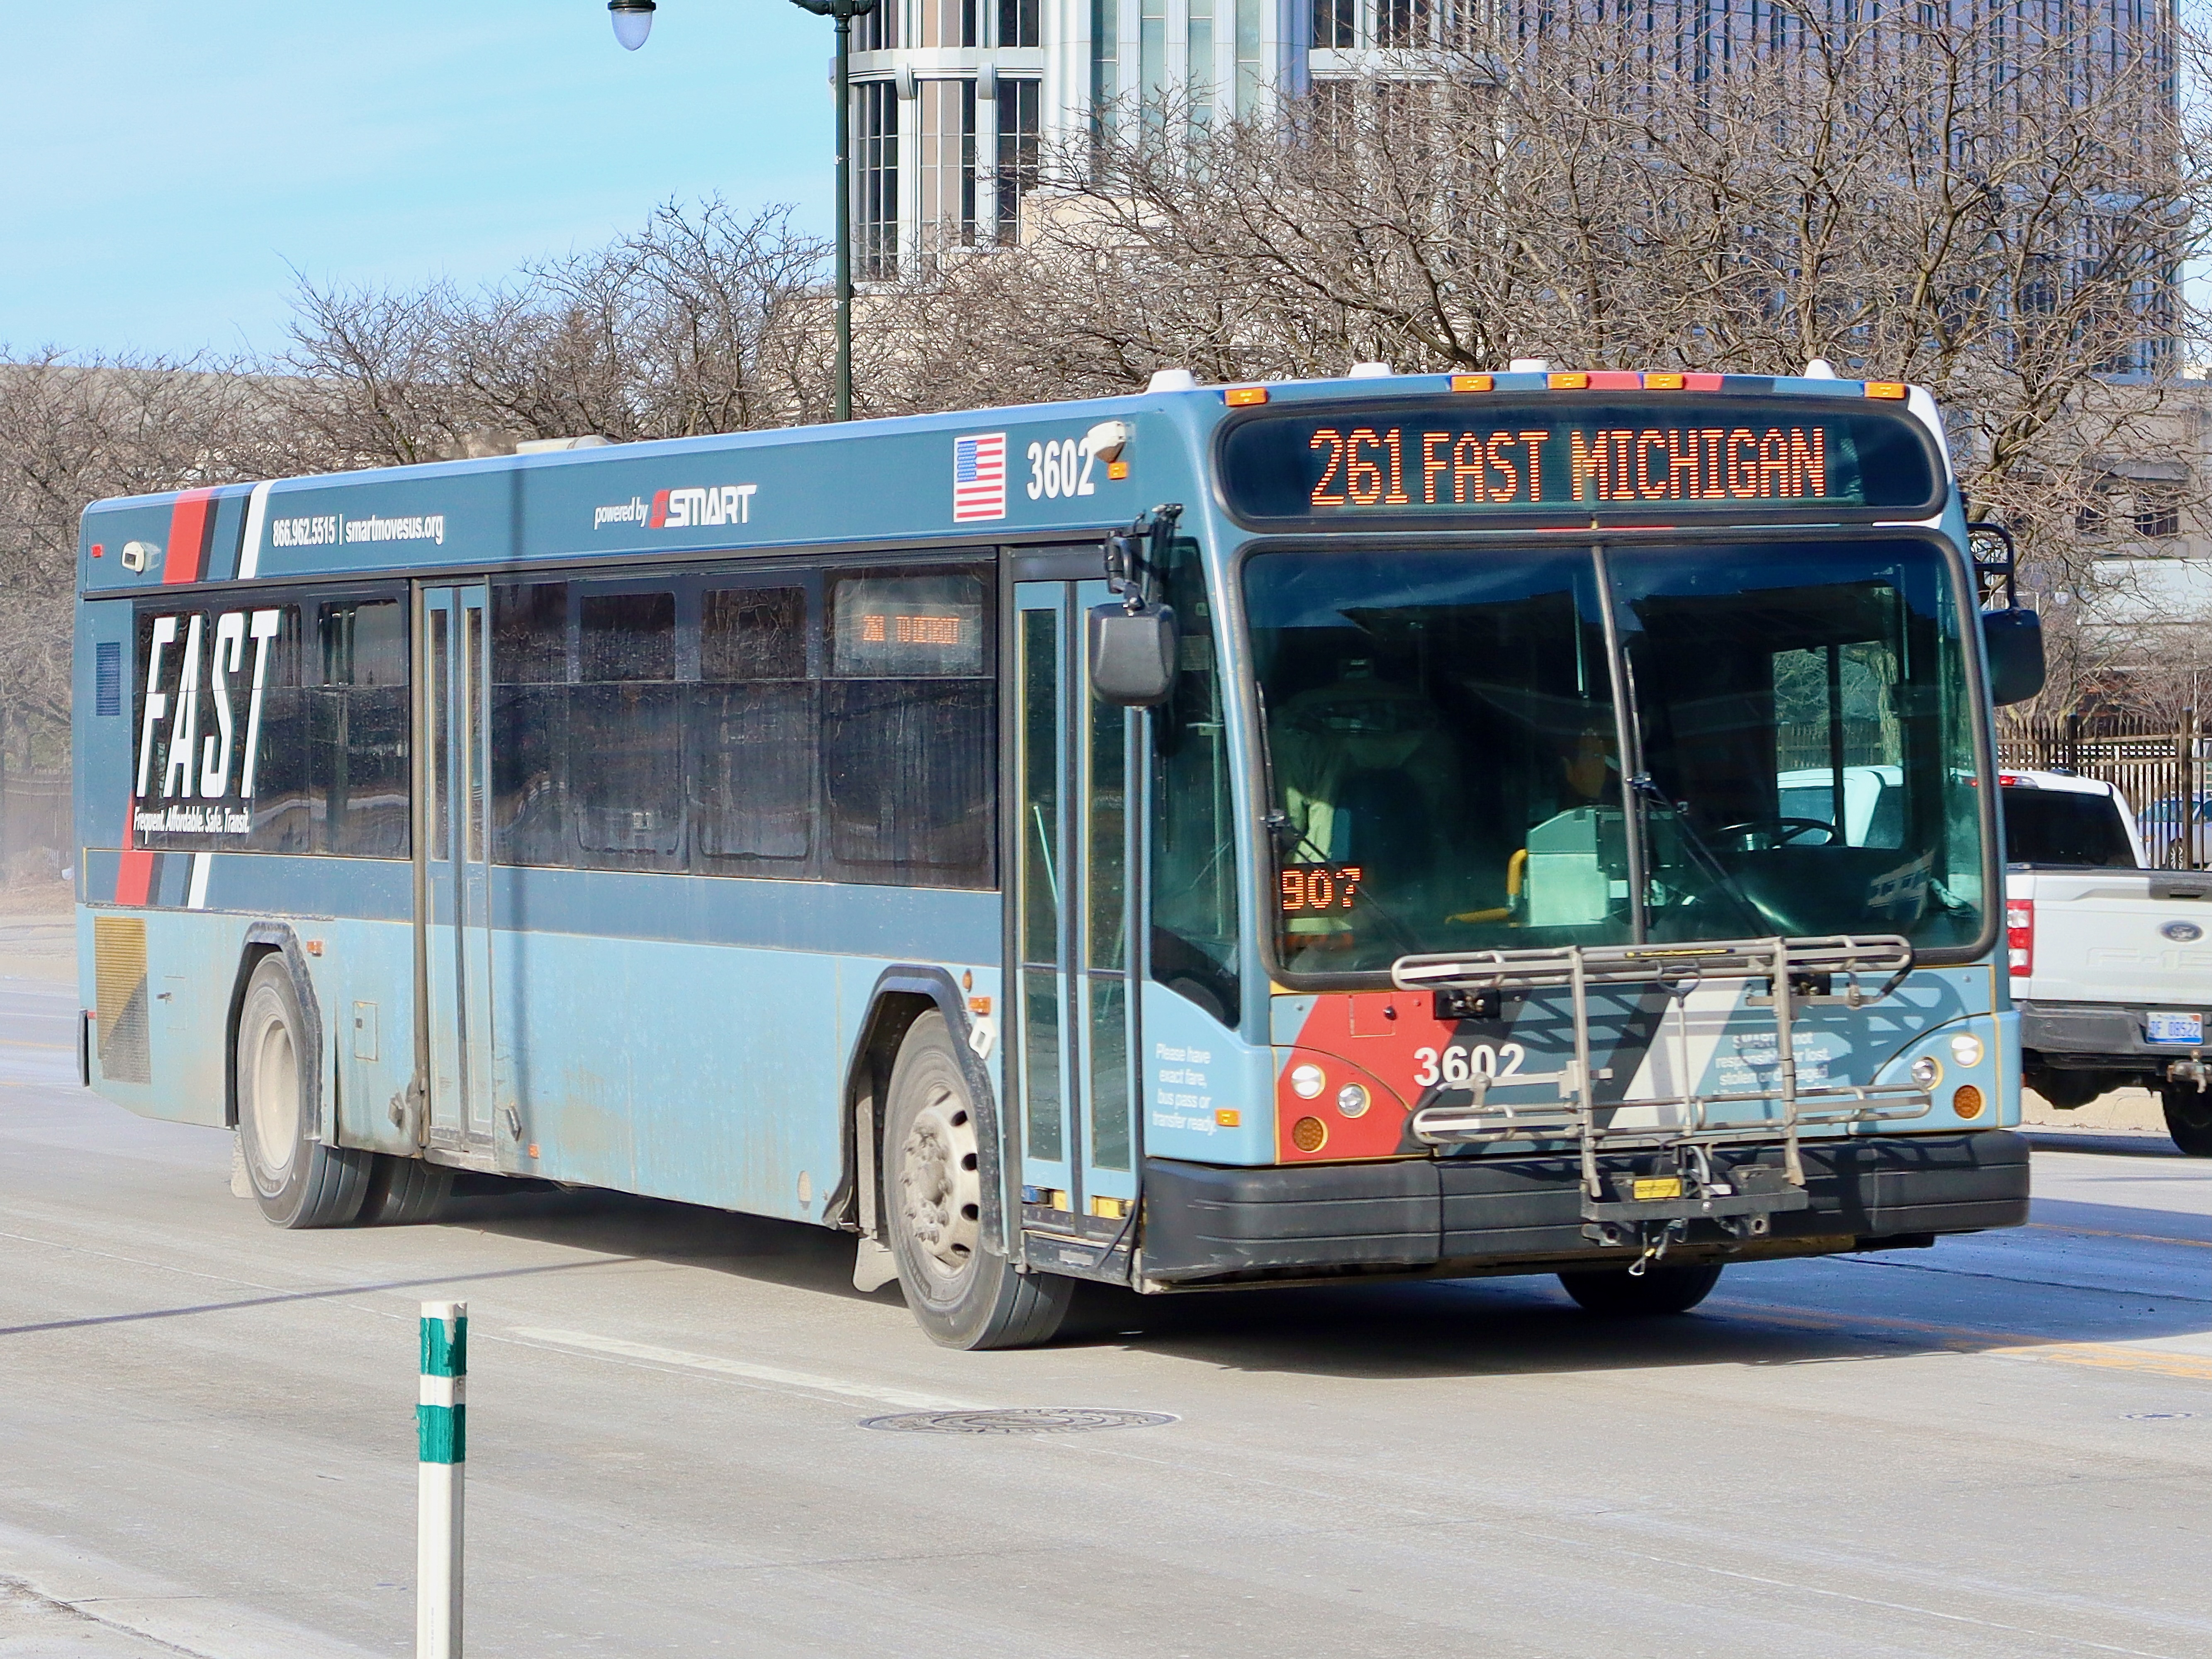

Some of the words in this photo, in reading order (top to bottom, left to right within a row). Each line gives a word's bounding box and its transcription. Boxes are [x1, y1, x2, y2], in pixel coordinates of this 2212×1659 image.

[1027, 438, 1095, 500] 3602
[1310, 427, 1409, 506] 261
[1422, 431, 1550, 503] FAST
[1570, 427, 1825, 501] MICHIGAN
[594, 497, 635, 530] powered
[635, 496, 649, 527] by
[664, 484, 757, 528] SMART
[272, 516, 336, 547] 866.962.5515
[345, 514, 444, 545] smartmovesus.org
[136, 609, 280, 798] FAST
[133, 806, 165, 845] Frequent.
[166, 805, 204, 832] Affordable.
[204, 806, 223, 833] Safe.
[224, 807, 250, 833] Transit.
[1282, 868, 1361, 910] 907
[1155, 1043, 1186, 1062] Please
[1187, 1046, 1211, 1064] have
[1791, 1032, 1815, 1045] not
[1158, 1069, 1184, 1084] exact
[1184, 1068, 1207, 1089] fare,
[1413, 1043, 1525, 1087] 3602
[1719, 1070, 1758, 1086] stolen
[1157, 1088, 1174, 1105] bus
[1174, 1094, 1198, 1110] pass
[1198, 1096, 1212, 1109] or
[1152, 1110, 1187, 1129] transfer
